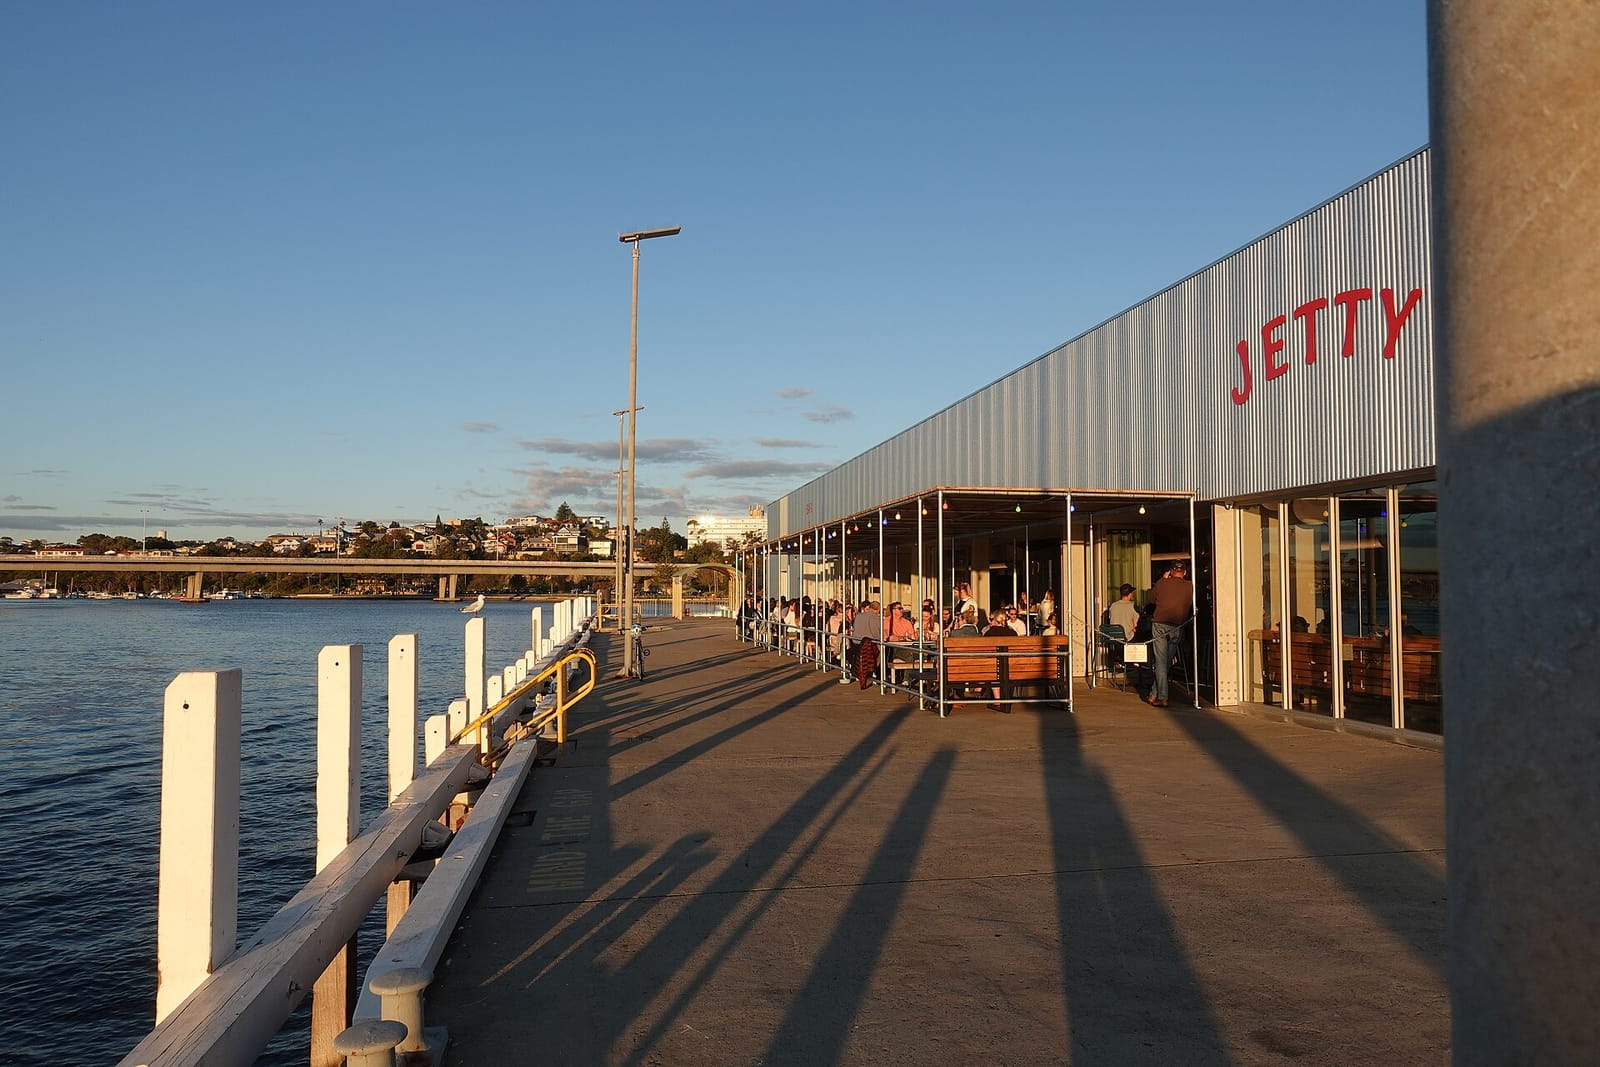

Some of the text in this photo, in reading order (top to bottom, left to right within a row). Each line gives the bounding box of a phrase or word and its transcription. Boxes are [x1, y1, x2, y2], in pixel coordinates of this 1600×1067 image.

[1232, 288, 1422, 405] JETTY
[542, 816, 592, 841] THE
[526, 851, 587, 893] MIND
